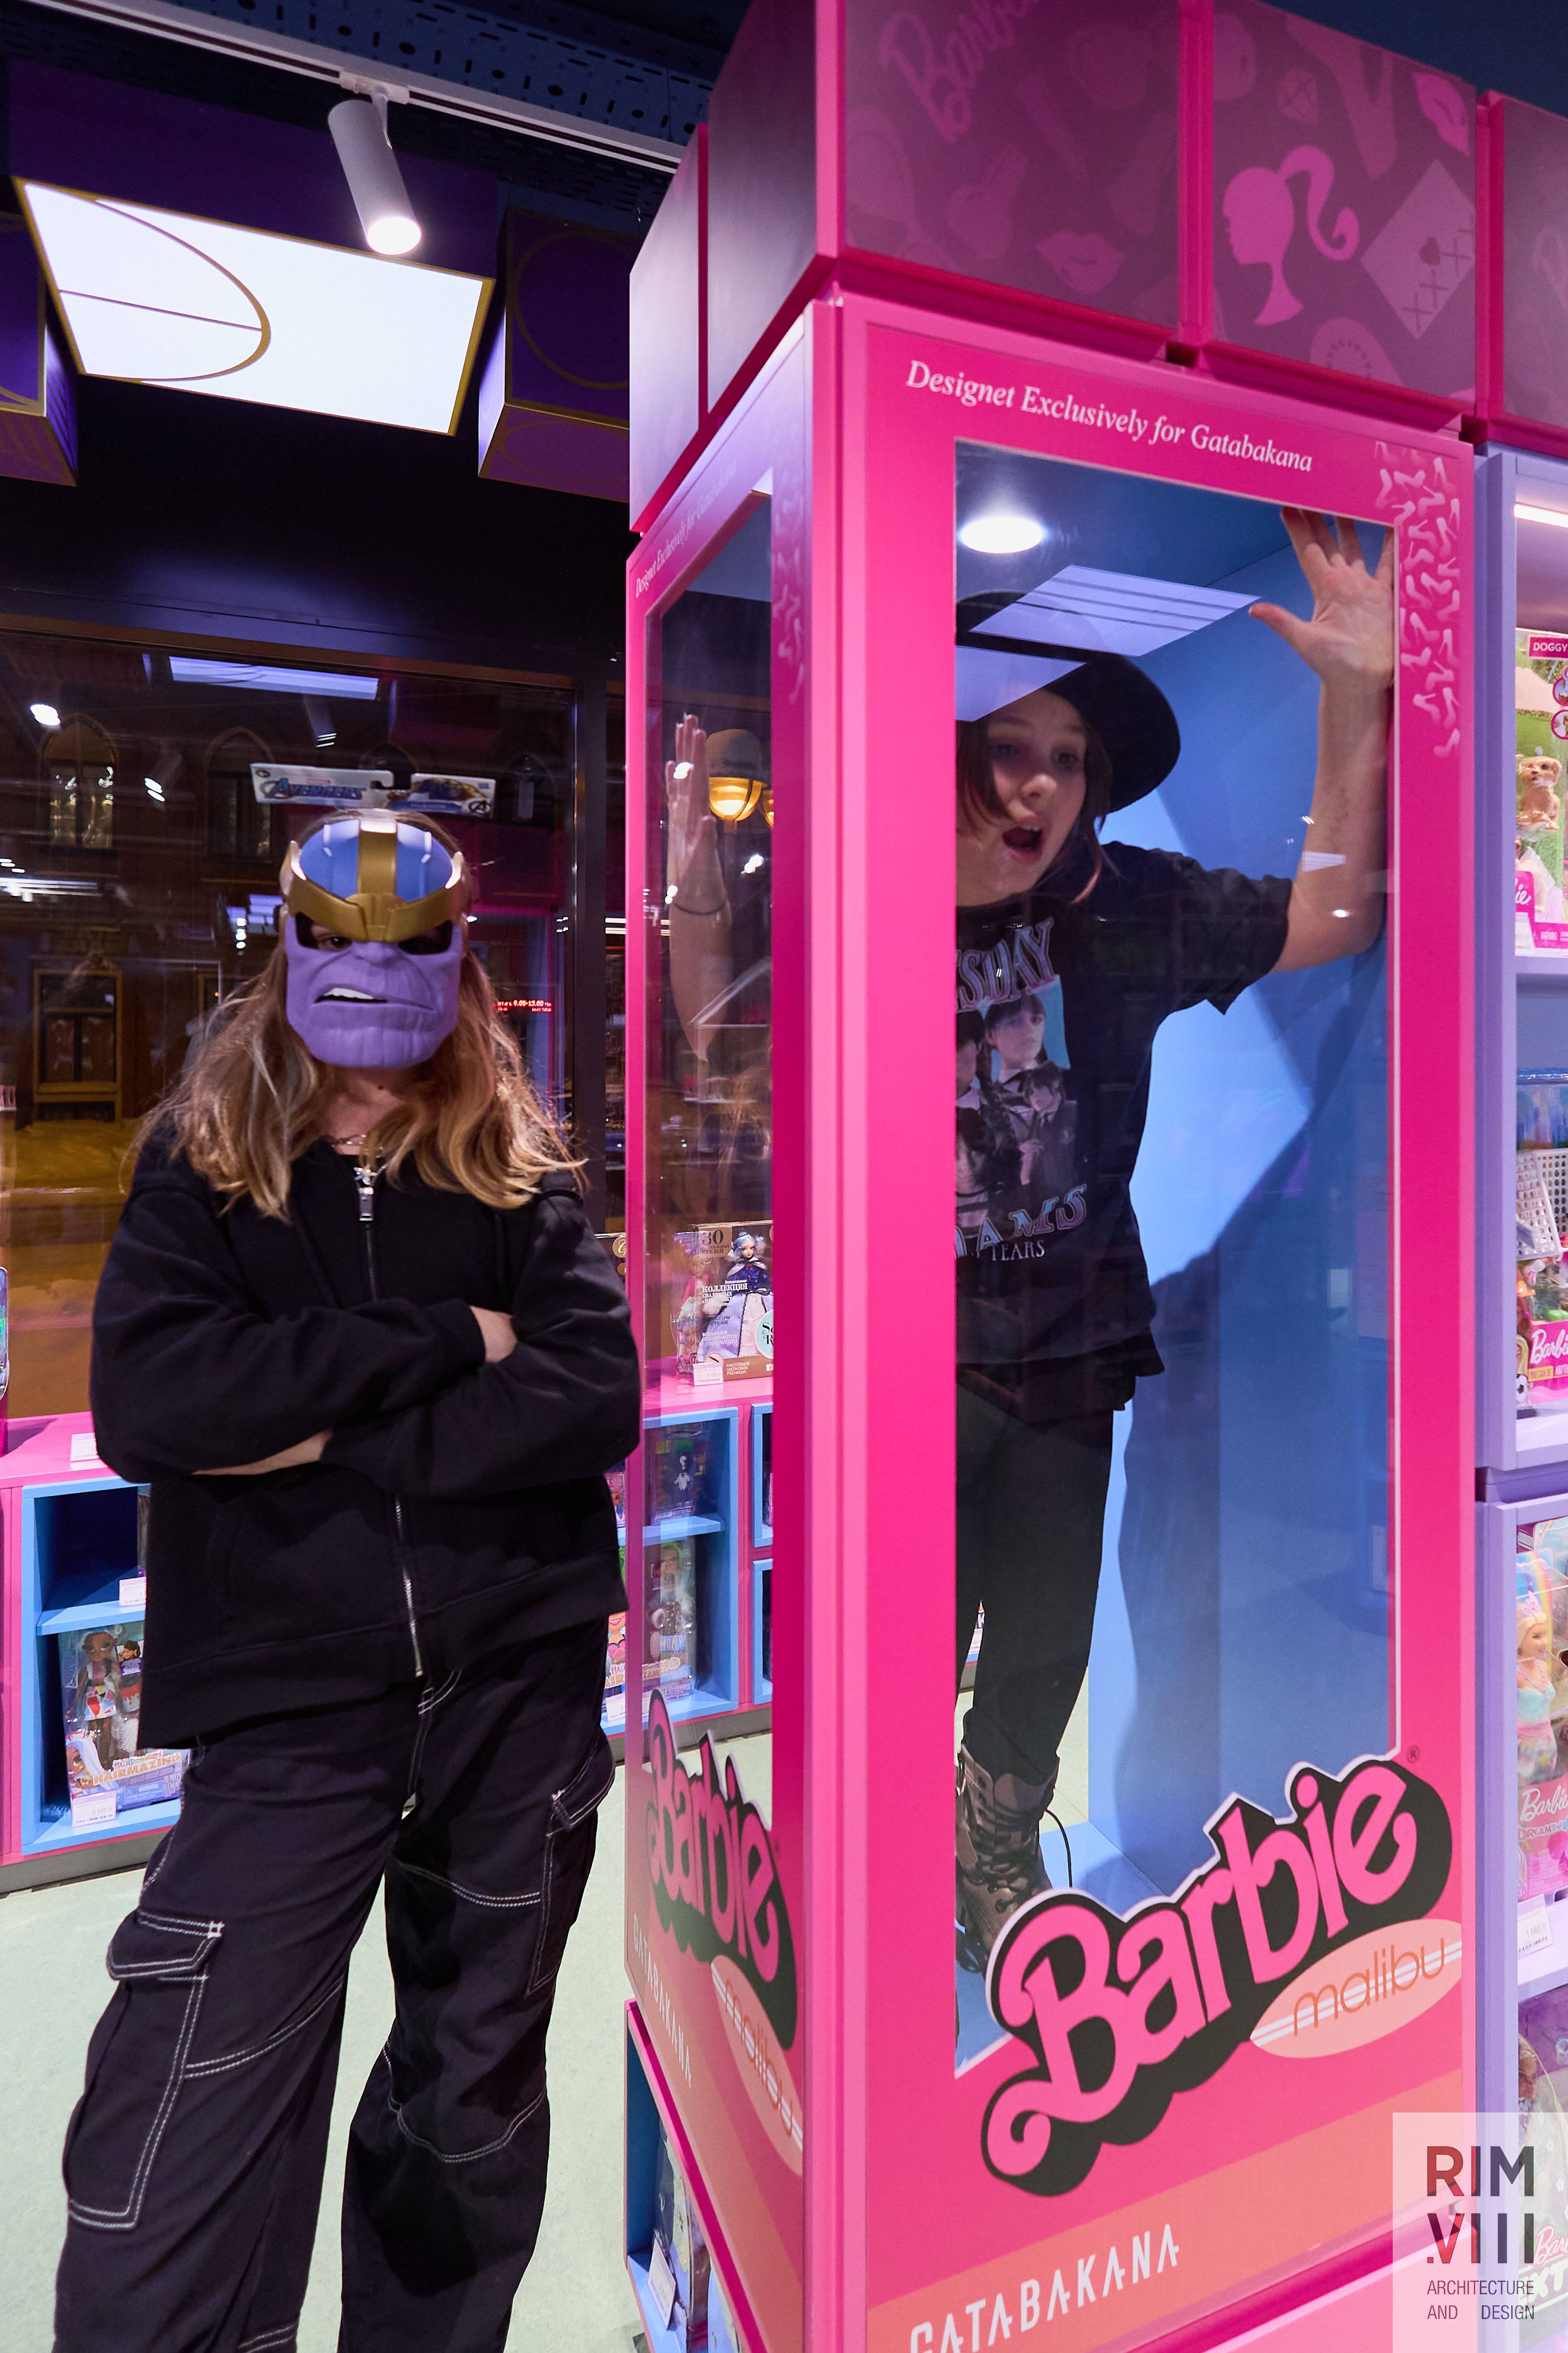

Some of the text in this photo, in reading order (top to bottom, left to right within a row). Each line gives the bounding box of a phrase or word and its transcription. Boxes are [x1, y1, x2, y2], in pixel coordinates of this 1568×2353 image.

[1021, 385, 1149, 442] Exclusively
[1148, 415, 1185, 446] for
[1191, 424, 1312, 472] Gatabakana
[1533, 642, 1568, 652] DOGGY
[702, 1229, 724, 1246] 30
[702, 1283, 748, 1293] КОЛЛЕКЦИЯ
[646, 1694, 781, 1983] Barbie
[633, 1913, 691, 2090] GATABAKANA
[984, 1762, 1429, 2180] Barbie
[1292, 1938, 1445, 2036] malibu
[725, 1979, 793, 2138] malibu
[910, 2222, 1179, 2353] GATABAKANA
[1532, 2225, 1568, 2266] Bar
